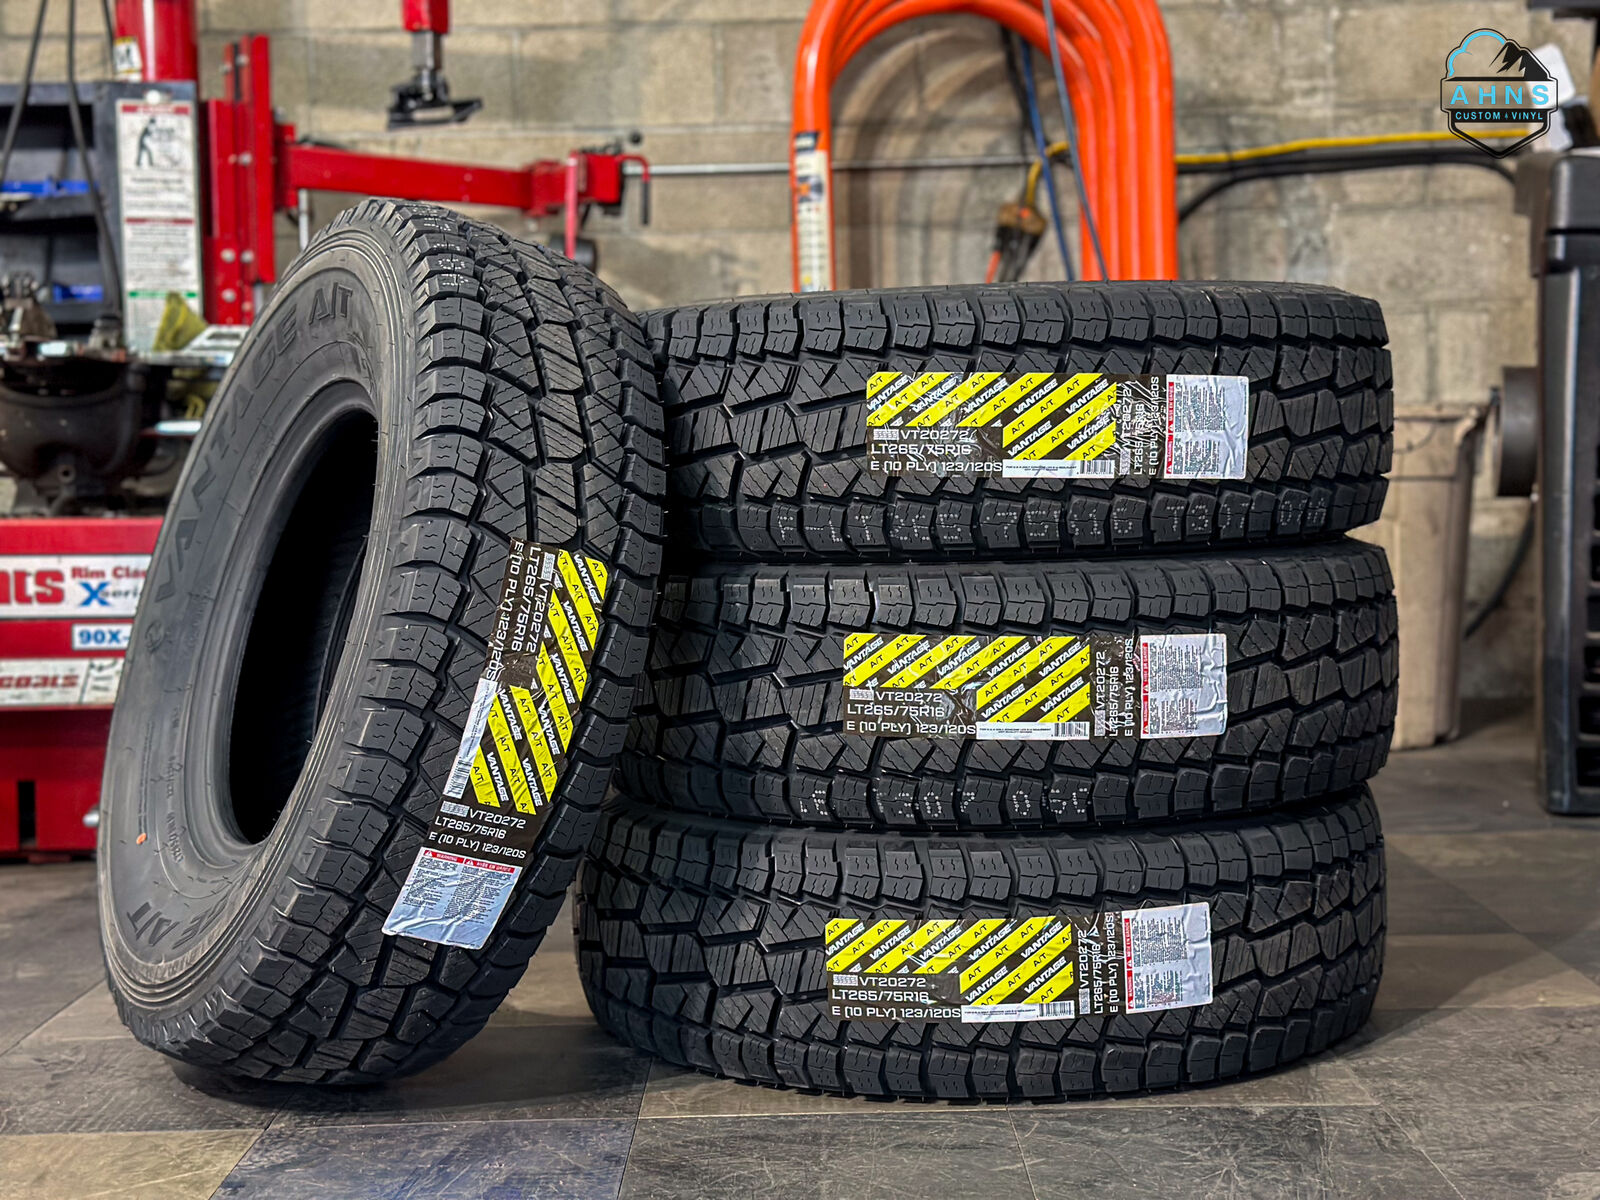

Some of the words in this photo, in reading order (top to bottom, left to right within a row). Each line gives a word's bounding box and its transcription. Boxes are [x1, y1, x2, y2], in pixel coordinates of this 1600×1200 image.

[308, 281, 353, 327] A/T
[867, 375, 909, 410] VANTAGE
[868, 375, 884, 390] A/T
[894, 393, 909, 407] A/T
[920, 374, 936, 388] A/T
[945, 393, 960, 407] A/T
[971, 373, 986, 388] A/T
[963, 378, 1008, 413] VANTAGE
[992, 397, 1007, 411] A/T
[1020, 378, 1034, 392] A/T
[1014, 378, 1058, 414] VANTAGE
[1065, 379, 1109, 414] VANTAGE
[1011, 420, 1025, 435] A/T
[1040, 399, 1054, 413] A/T
[1066, 379, 1080, 394] A/T
[901, 430, 969, 440] VT20272
[1008, 420, 1052, 456] VANTAGE
[1050, 428, 1065, 443] A/T
[1077, 409, 1091, 424] A/T
[1067, 411, 1111, 450] VANTAGE
[870, 461, 880, 471] E
[941, 462, 1003, 472] 123/120S
[871, 444, 972, 455] LT265/75R16
[1082, 445, 1096, 459] A/T
[1149, 467, 1157, 475] E
[515, 541, 524, 552] E
[71, 566, 105, 579] Rim
[573, 554, 600, 603] VANTAGE
[592, 562, 604, 578] A/T
[511, 547, 541, 652] LT265/75R16
[572, 584, 584, 599] A/T
[585, 615, 597, 631] A/T
[527, 582, 550, 653] VT20272
[563, 600, 588, 652] VANTAGE
[487, 614, 510, 682] 123/120S
[562, 635, 573, 651] A/T
[574, 667, 585, 683] A/T
[843, 637, 884, 671] VANTAGE
[846, 636, 860, 650] A/T
[869, 654, 884, 669] A/T
[895, 636, 910, 650] A/T
[887, 640, 931, 674] VANTAGE
[919, 656, 933, 670] A/T
[945, 637, 960, 651] A/T
[937, 641, 981, 676] VANTAGE
[966, 660, 980, 674] A/T
[992, 640, 1007, 655] A/T
[987, 641, 1031, 677] VANTAGE
[1039, 641, 1081, 677] VANTAGE
[551, 653, 575, 704] VANTAGE
[985, 683, 999, 697] A/T
[1013, 662, 1027, 676] A/T
[1039, 643, 1053, 657] A/T
[1125, 638, 1134, 684] 123/120S
[875, 691, 943, 702] VT20272
[1024, 691, 1038, 706] A/T
[1050, 672, 1064, 686] A/T
[1040, 676, 1084, 713] VANTAGE
[1096, 651, 1106, 709] VT20272
[498, 688, 522, 740] VANTAGE
[547, 684, 558, 700] A/T
[557, 715, 568, 731] A/T
[847, 704, 945, 717] LT265/75R16
[981, 683, 1025, 718] VANTAGE
[1056, 707, 1070, 721] A/T
[520, 698, 531, 714] A/T
[532, 731, 543, 747] A/T
[542, 762, 552, 778] A/T
[538, 707, 560, 755] VANTAGE
[846, 721, 855, 731] E
[916, 724, 976, 734] 123/120S
[1125, 728, 1133, 736] E
[473, 766, 484, 782] A/T
[487, 752, 509, 801] VANTAGE
[500, 736, 510, 752] A/T
[510, 768, 520, 783] A/T
[522, 758, 543, 807] VANTAGE
[435, 816, 507, 839] LT265/75R16
[469, 809, 527, 829] VT20272
[428, 832, 438, 841] E
[482, 843, 527, 858] 123/120S
[825, 922, 865, 956] VANTAGE
[827, 922, 840, 936] A/T
[852, 940, 866, 955] A/T
[876, 921, 891, 936] A/T
[869, 925, 911, 960] VANTAGE
[900, 940, 915, 955] A/T
[926, 921, 940, 936] A/T
[920, 925, 962, 960] VANTAGE
[948, 944, 962, 958] A/T
[973, 924, 988, 939] A/T
[969, 923, 1012, 960] VANTAGE
[1021, 921, 1063, 958] VANTAGE
[1106, 914, 1115, 960] 123/120S
[968, 966, 982, 981] A/T
[995, 944, 1009, 959] A/T
[1020, 924, 1034, 939] A/T
[1078, 930, 1089, 988] VT20272
[859, 977, 927, 988] VT20272
[965, 966, 1008, 1002] VANTAGE
[1007, 973, 1022, 988] A/T
[1033, 953, 1047, 967] A/T
[1024, 956, 1066, 994] VANTAGE
[1092, 944, 1103, 1014] LT265/75R16
[831, 1006, 841, 1015] E
[901, 1008, 960, 1018] 123/120S
[832, 989, 929, 1001] LT265/75R16
[1040, 987, 1054, 1002] A/T
[1110, 1005, 1118, 1013] E
